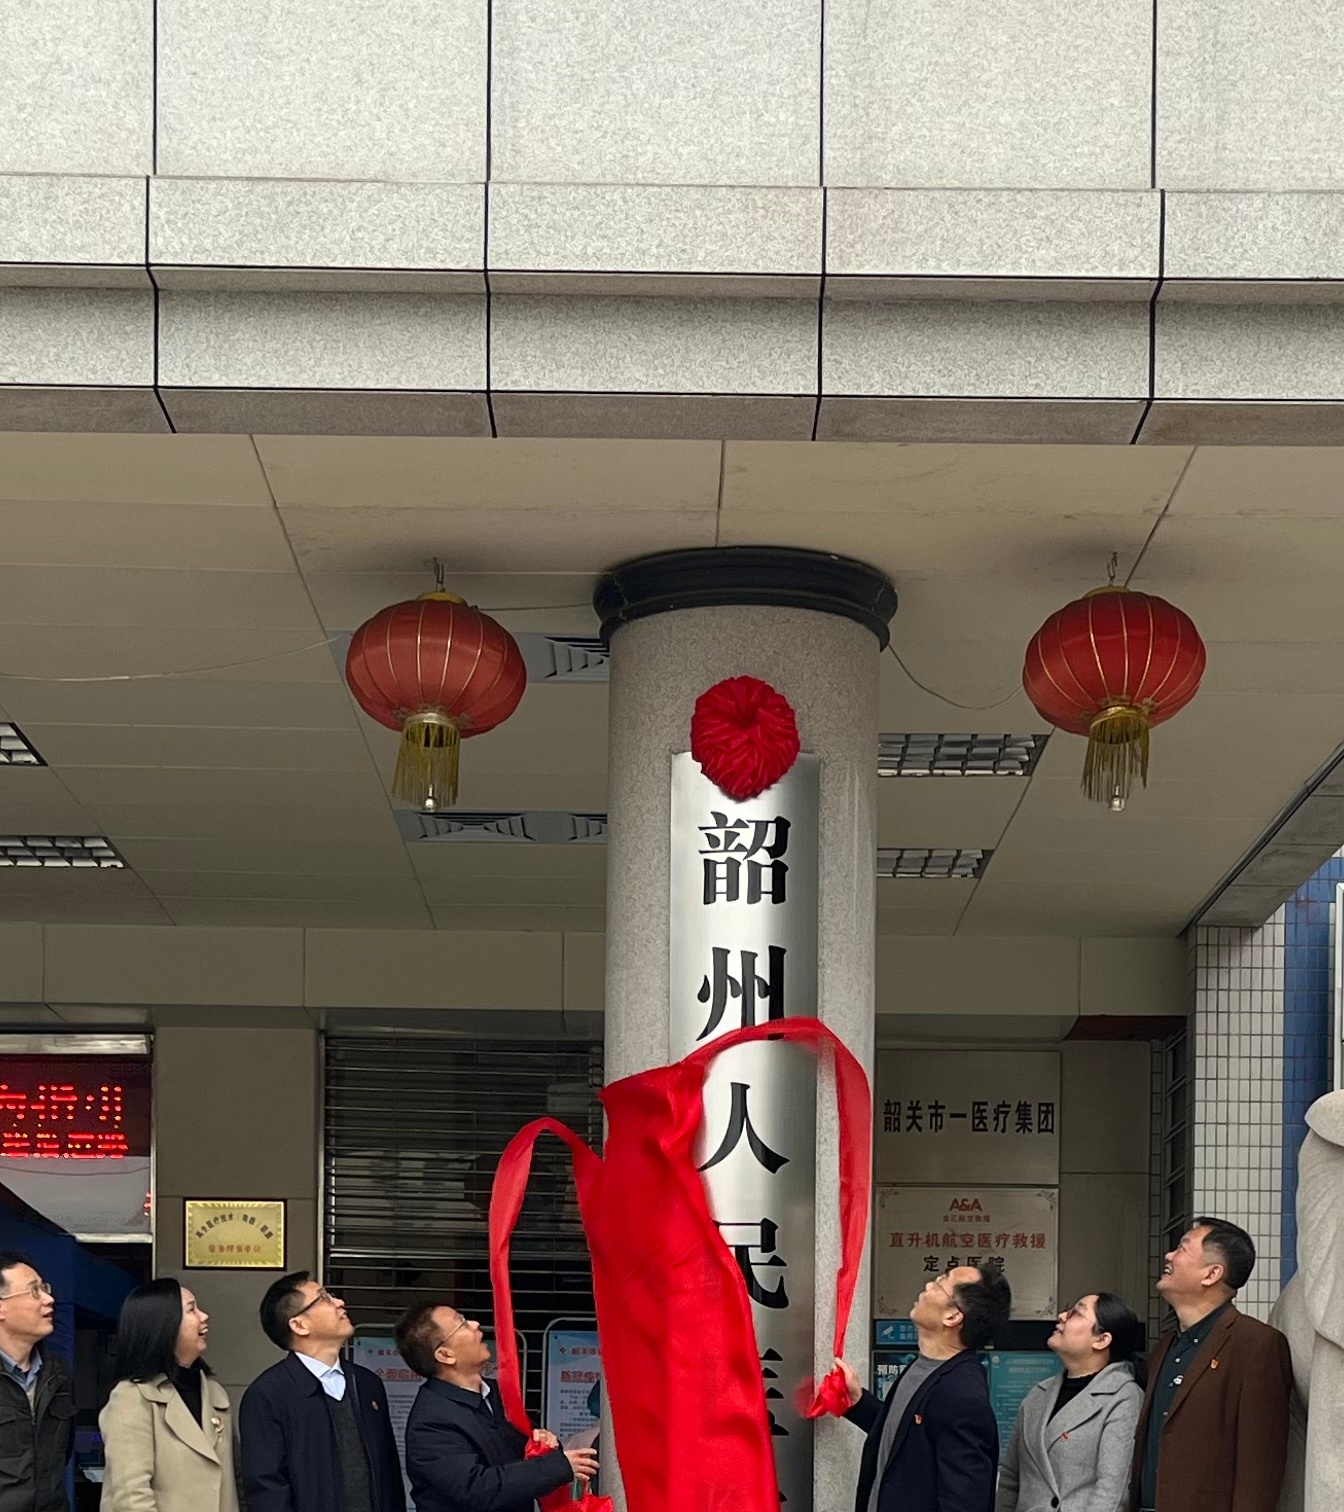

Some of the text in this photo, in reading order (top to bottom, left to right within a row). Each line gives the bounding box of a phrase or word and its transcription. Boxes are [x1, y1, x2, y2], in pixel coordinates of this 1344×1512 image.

[696, 810, 792, 1440] 韶州人民
[883, 1099, 1055, 1134] 韶关市一医疗集团
[949, 1198, 983, 1212] A&A
[889, 1232, 1046, 1249] 直升机航空医疗救援
